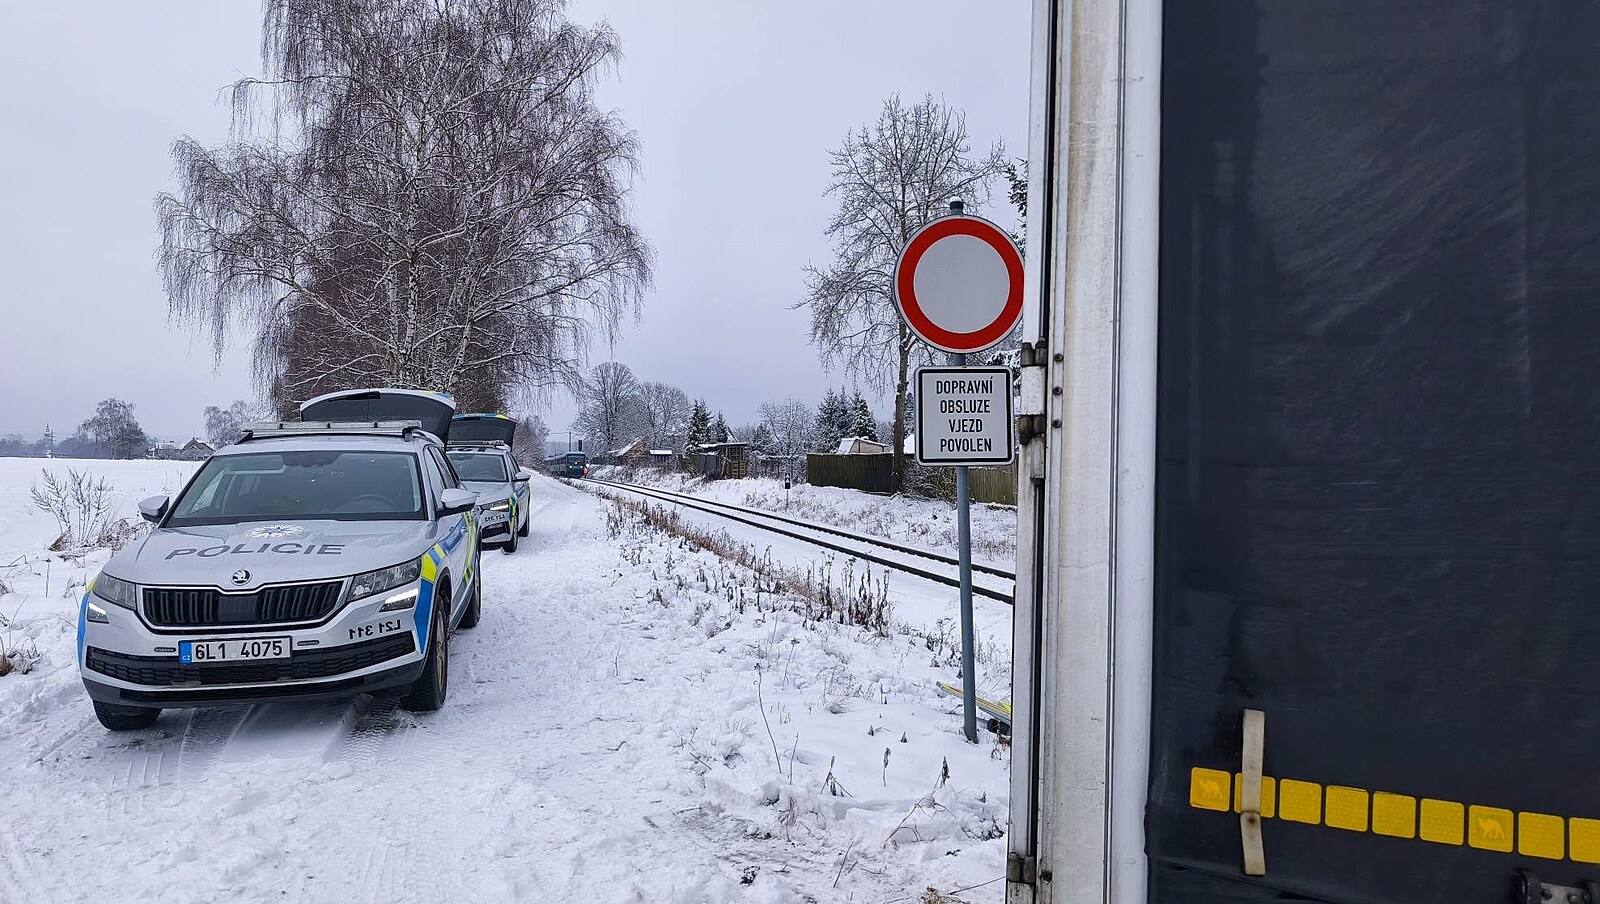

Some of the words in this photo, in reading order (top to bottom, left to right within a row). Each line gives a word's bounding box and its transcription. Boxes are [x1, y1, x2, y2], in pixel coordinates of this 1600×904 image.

[936, 376, 993, 394] DOPRAVNÍ
[940, 400, 990, 413] OBSLUZE
[949, 419, 983, 433] VJEZD
[940, 438, 992, 452] POVOLEN
[164, 542, 347, 561] POLICIE
[195, 643, 226, 660] 6L1
[240, 641, 283, 658] 4075
